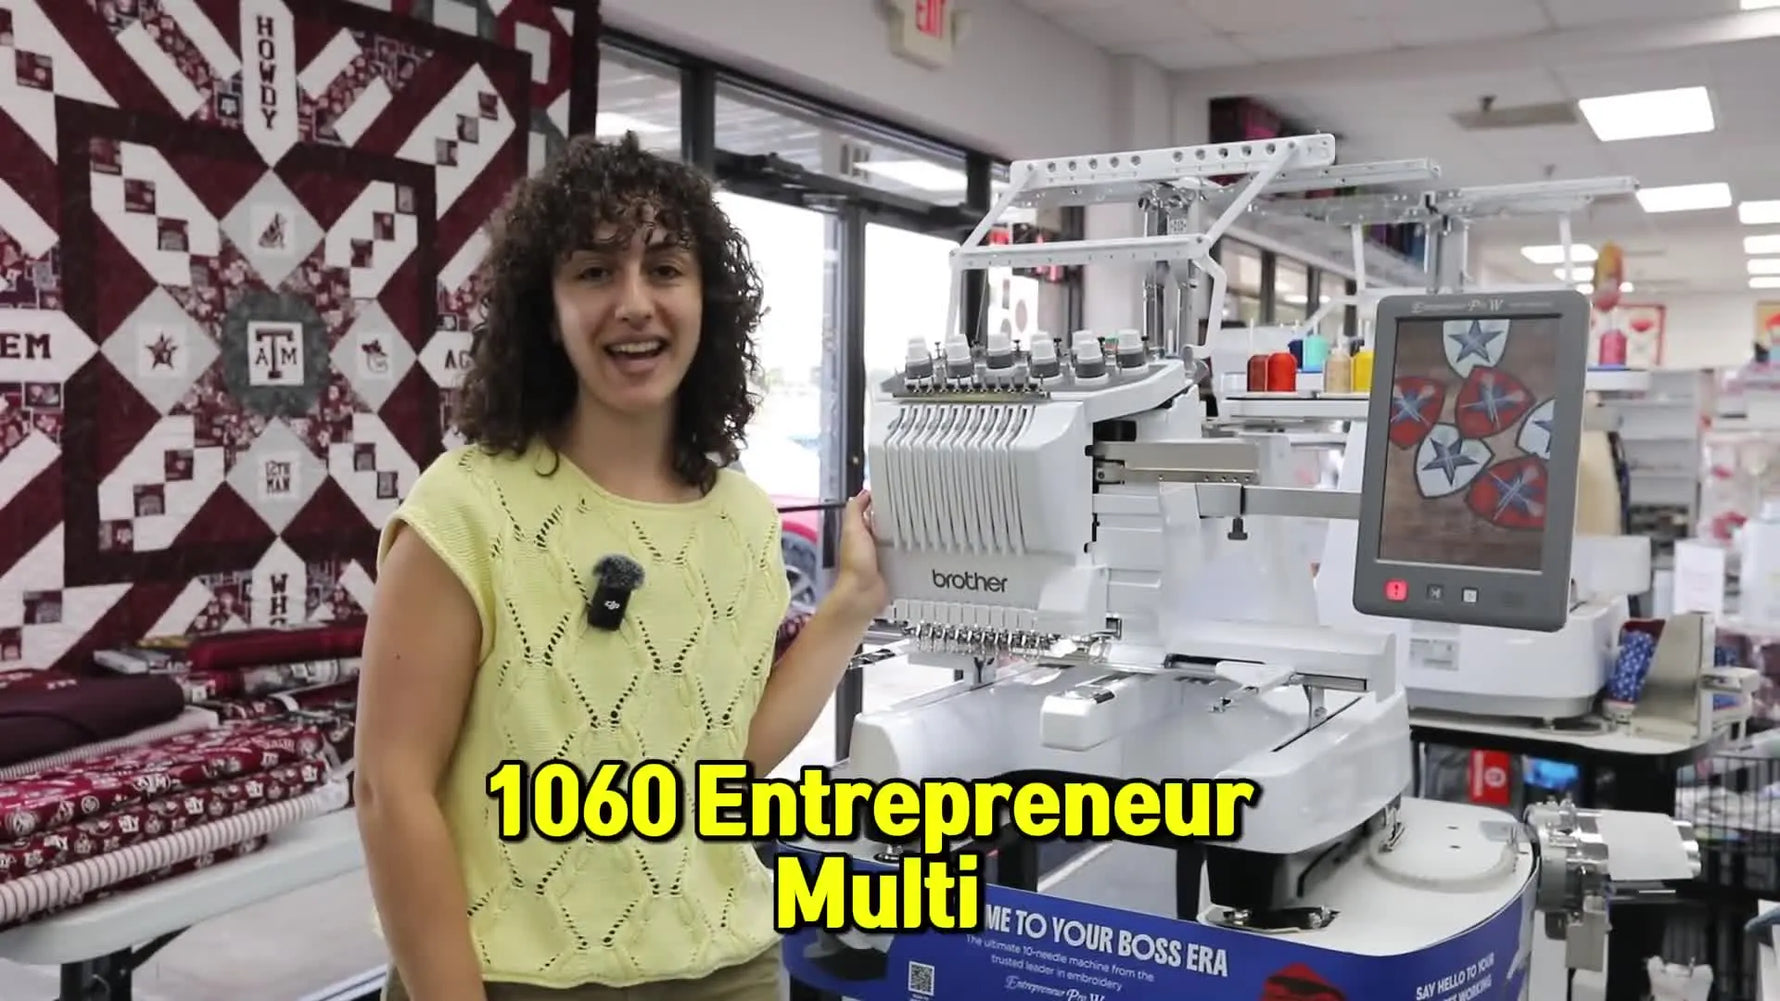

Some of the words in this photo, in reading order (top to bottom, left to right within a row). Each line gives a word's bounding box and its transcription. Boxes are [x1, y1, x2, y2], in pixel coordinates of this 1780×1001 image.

[256, 14, 277, 130] HOWDY
[0, 332, 52, 359] EM
[932, 569, 1008, 592] brother
[966, 933, 983, 946] The
[984, 939, 1021, 954] ultimate
[1023, 945, 1067, 964] 10-needle
[1069, 956, 1110, 973] machine
[1112, 964, 1136, 979] from
[1138, 971, 1155, 982] the
[1016, 909, 1047, 939] TO
[1052, 916, 1114, 954] YOUR
[1118, 929, 1182, 968] BOSS
[1186, 942, 1228, 978] ERA
[991, 954, 1024, 969] trusted
[1025, 961, 1055, 976] leader
[1057, 969, 1065, 979] in
[1066, 971, 1122, 992] embroidery
[1416, 980, 1436, 1001] SAY
[1437, 970, 1466, 995] HELLO
[1467, 963, 1477, 981] TO
[1478, 952, 1495, 974] YOUR
